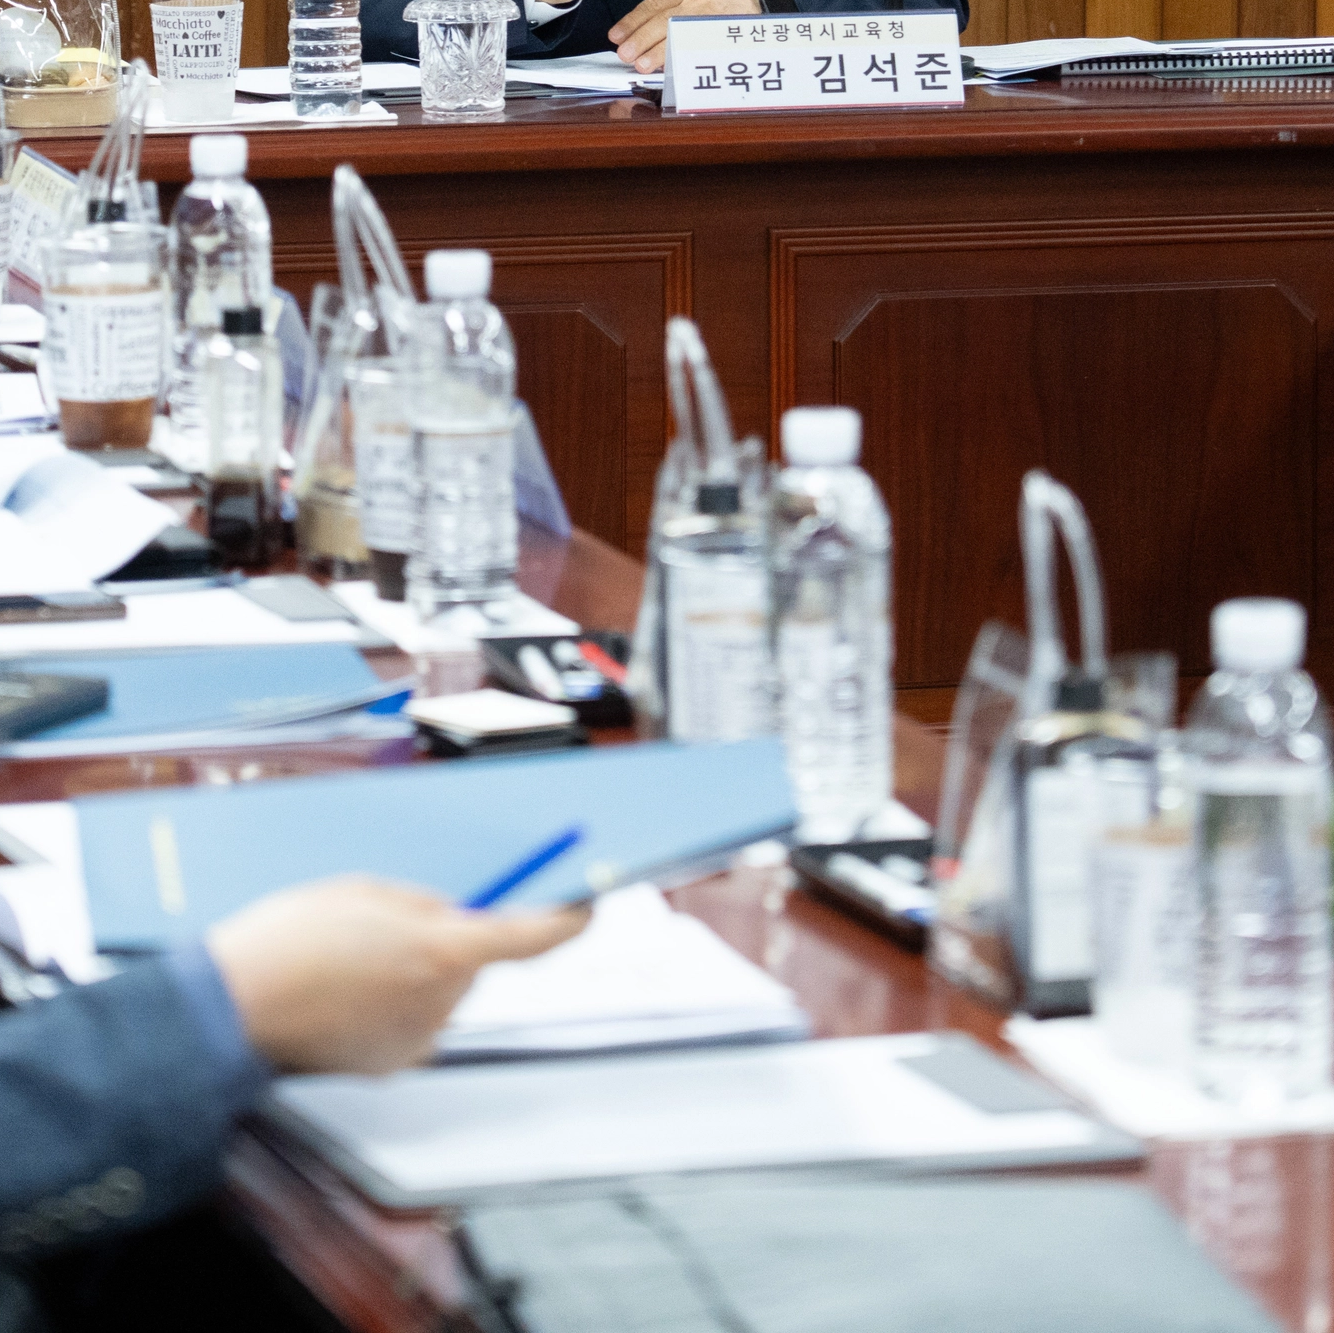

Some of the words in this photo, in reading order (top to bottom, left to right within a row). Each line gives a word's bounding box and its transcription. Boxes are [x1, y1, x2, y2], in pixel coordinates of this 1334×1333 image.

[156, 18, 212, 30] Macchiato
[192, 30, 222, 41] Coffee
[726, 21, 906, 44] 부산광역시교육청
[172, 43, 222, 58] LATTE
[693, 61, 785, 93] 교육감
[813, 52, 952, 94] 김석준
